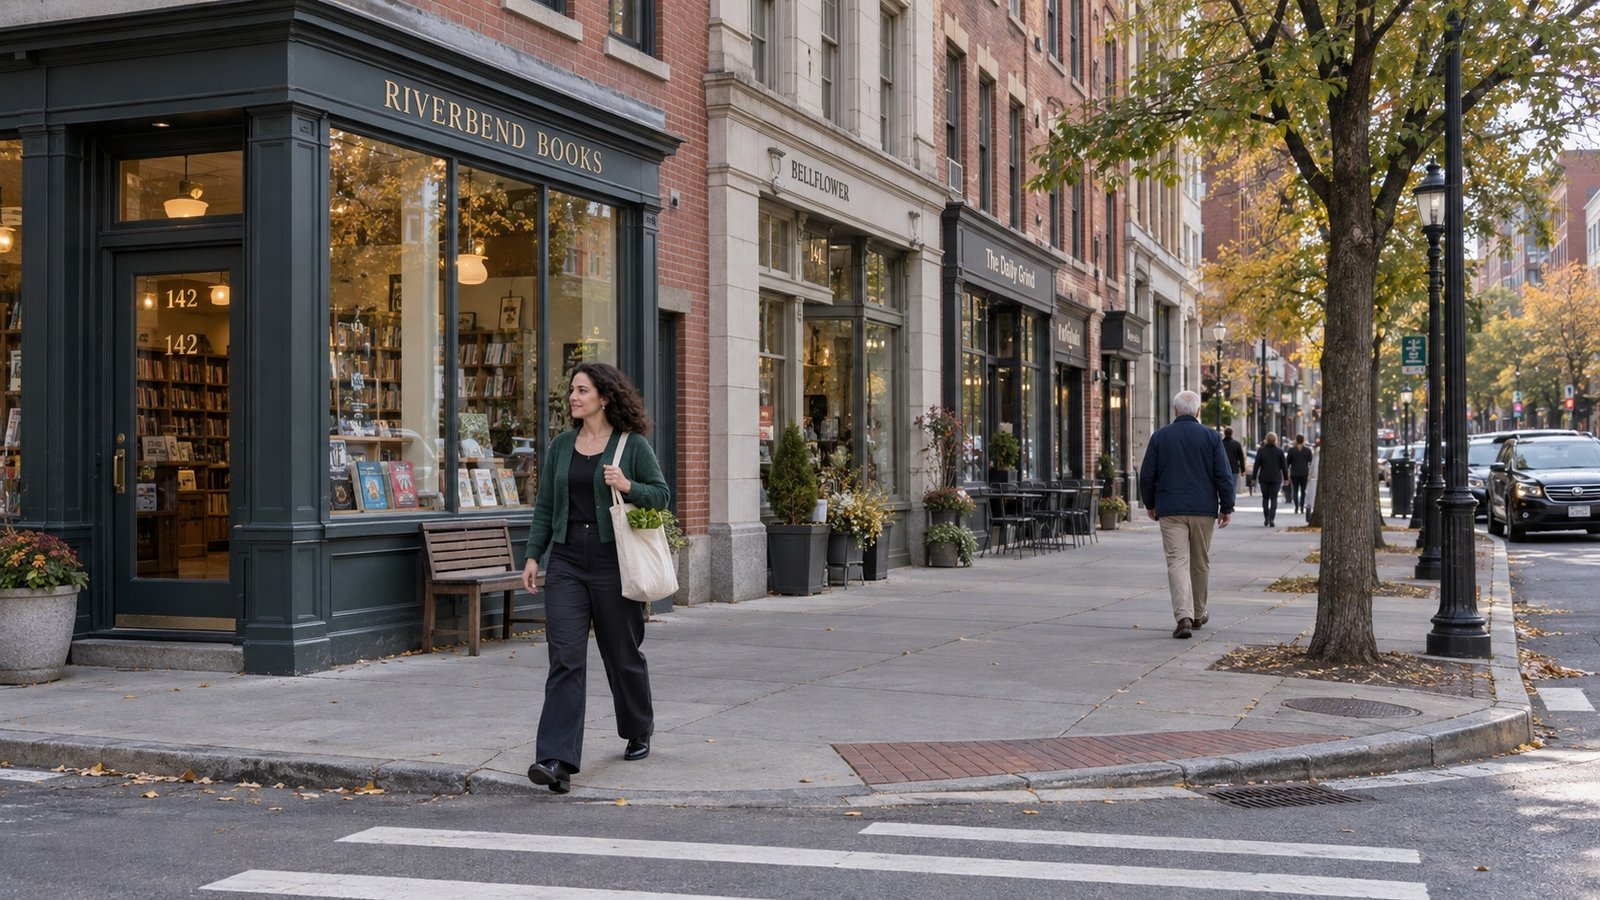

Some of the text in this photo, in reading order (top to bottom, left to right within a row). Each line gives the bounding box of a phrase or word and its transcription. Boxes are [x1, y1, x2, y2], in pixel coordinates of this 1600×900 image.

[384, 79, 603, 174] RIVERBEND BOOKS
[791, 160, 850, 202] BELLFLOWER
[985, 248, 1036, 289] The Daily Grind
[166, 288, 198, 309] 142
[164, 334, 198, 356] 142
